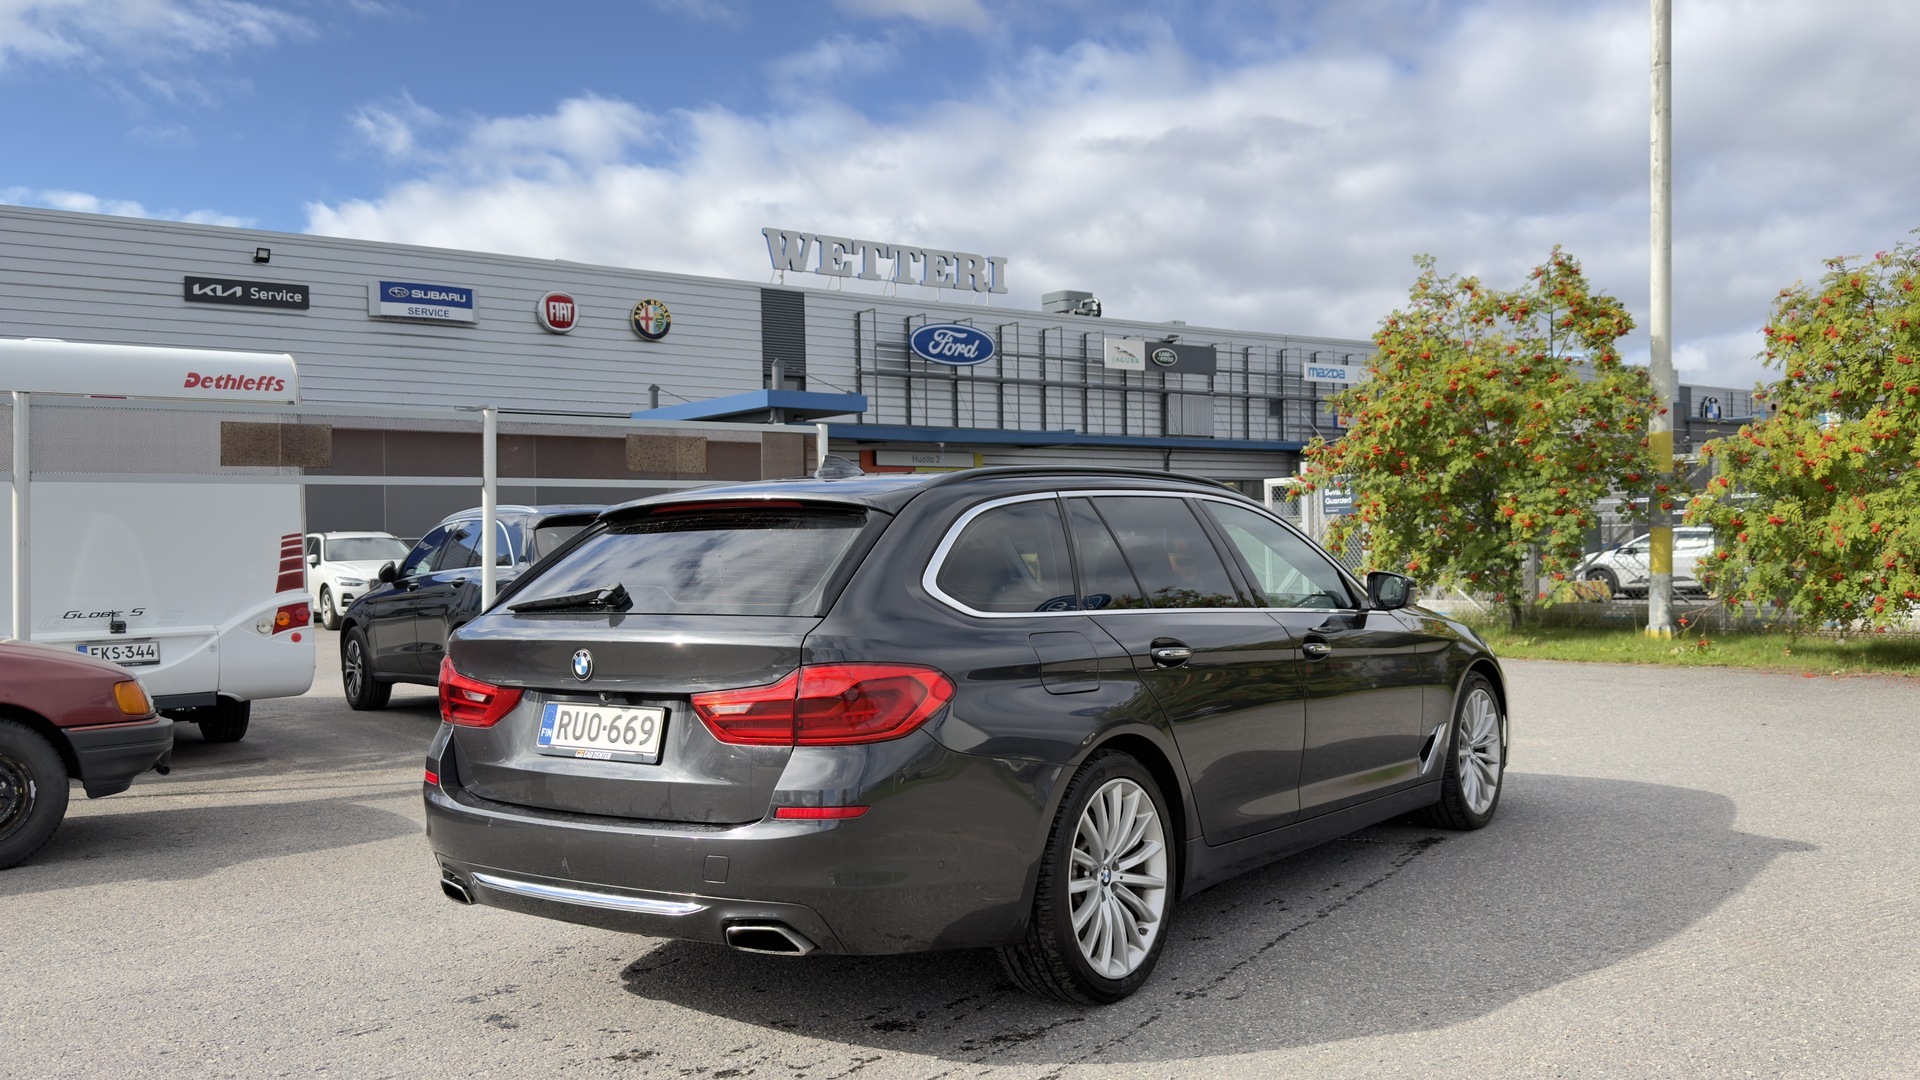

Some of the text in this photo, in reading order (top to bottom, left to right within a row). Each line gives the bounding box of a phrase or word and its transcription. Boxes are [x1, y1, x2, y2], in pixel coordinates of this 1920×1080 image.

[762, 227, 1008, 294] WETTERI
[250, 287, 302, 302] Service
[411, 289, 466, 302] SUBARU
[408, 307, 450, 318] SERVICE
[549, 301, 574, 322] FIAT
[634, 300, 671, 323] ALFA ROMEO
[928, 329, 979, 359] Ford
[1112, 356, 1139, 364] JAGUAR
[184, 372, 285, 392] Dethleffs
[1325, 496, 1352, 504] Guarded
[129, 607, 146, 616] S
[541, 727, 553, 738] FIN
[557, 711, 655, 746] RUO-669
